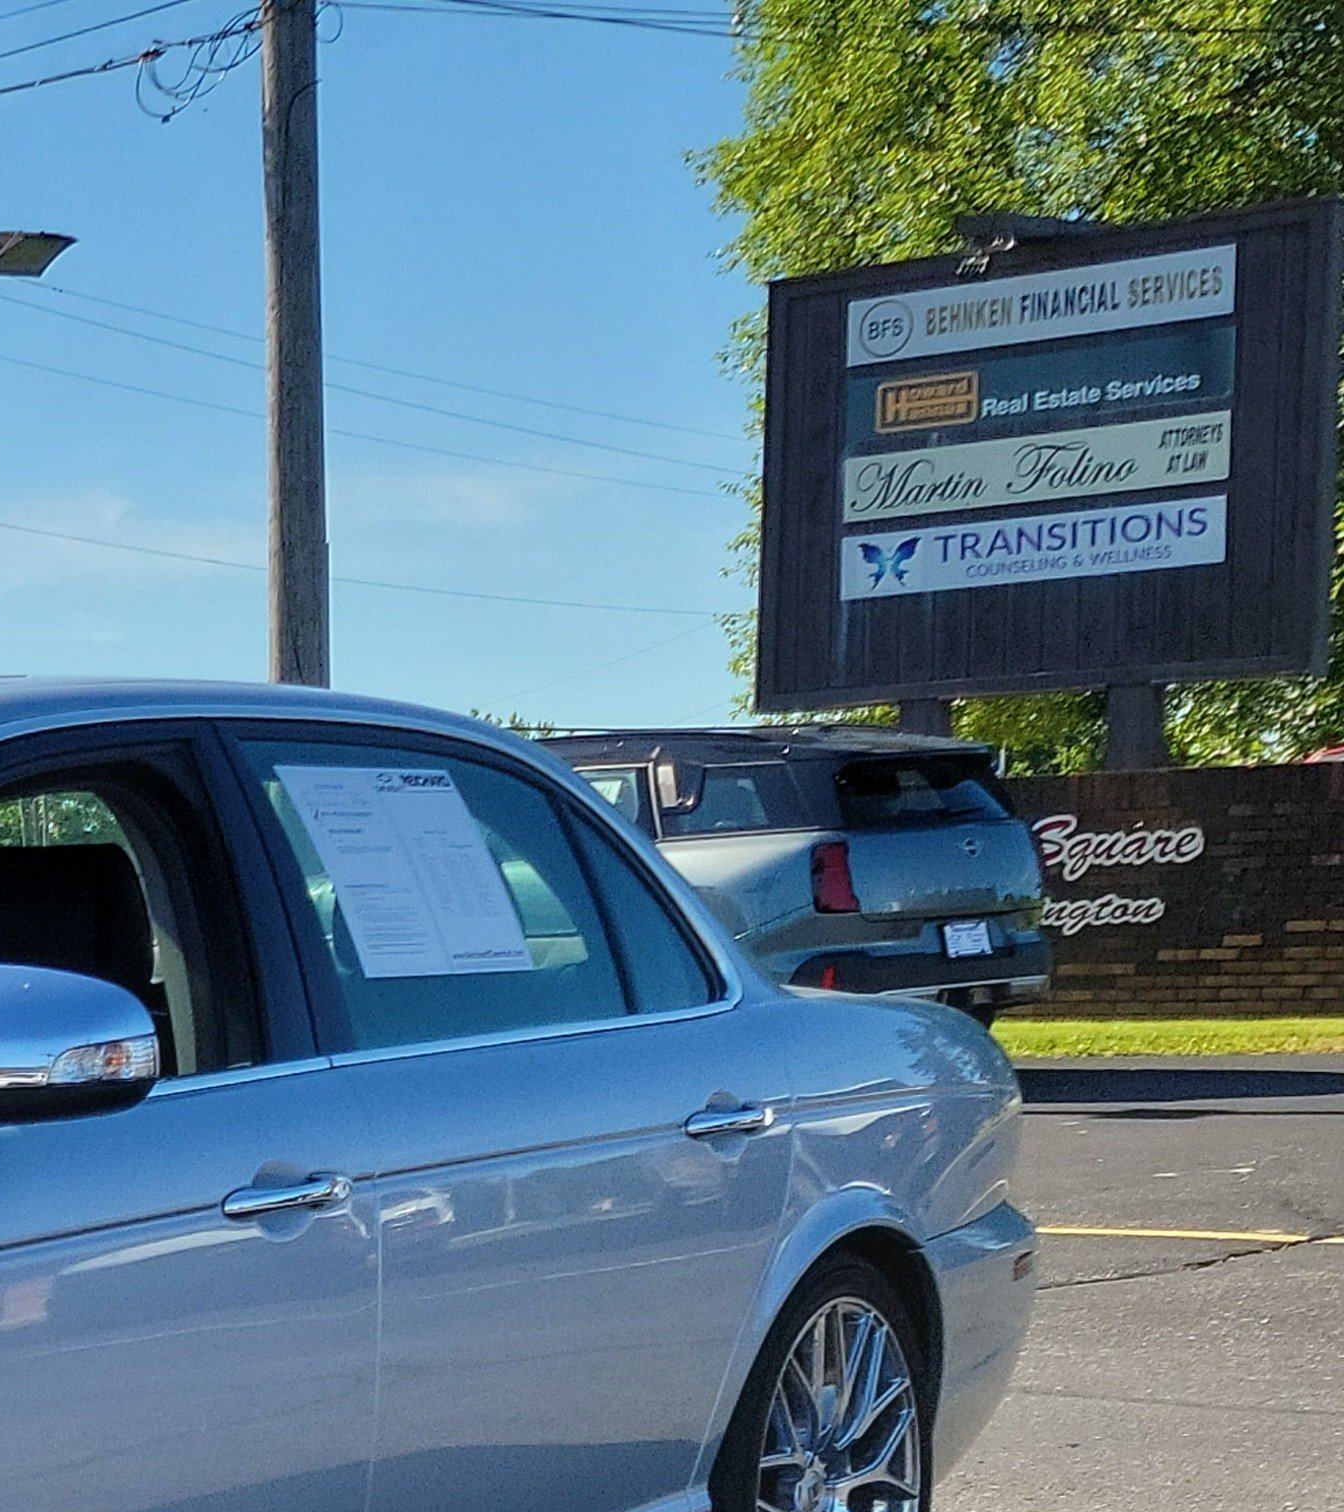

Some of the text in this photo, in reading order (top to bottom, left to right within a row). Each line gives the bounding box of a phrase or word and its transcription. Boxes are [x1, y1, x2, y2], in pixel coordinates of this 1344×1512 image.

[866, 264, 1224, 342] BFS BEHNKEN FINANCIAL SERVICES
[980, 373, 1201, 419] Real Estate Services
[1158, 423, 1224, 450] ATTORNEYS
[849, 440, 1138, 512] Martin Folino
[934, 507, 1208, 563] TRANSITIONS
[965, 544, 1173, 579] COUNSELING & WELLNESS
[1031, 814, 1204, 882] Square
[1041, 893, 1166, 936] ngton
